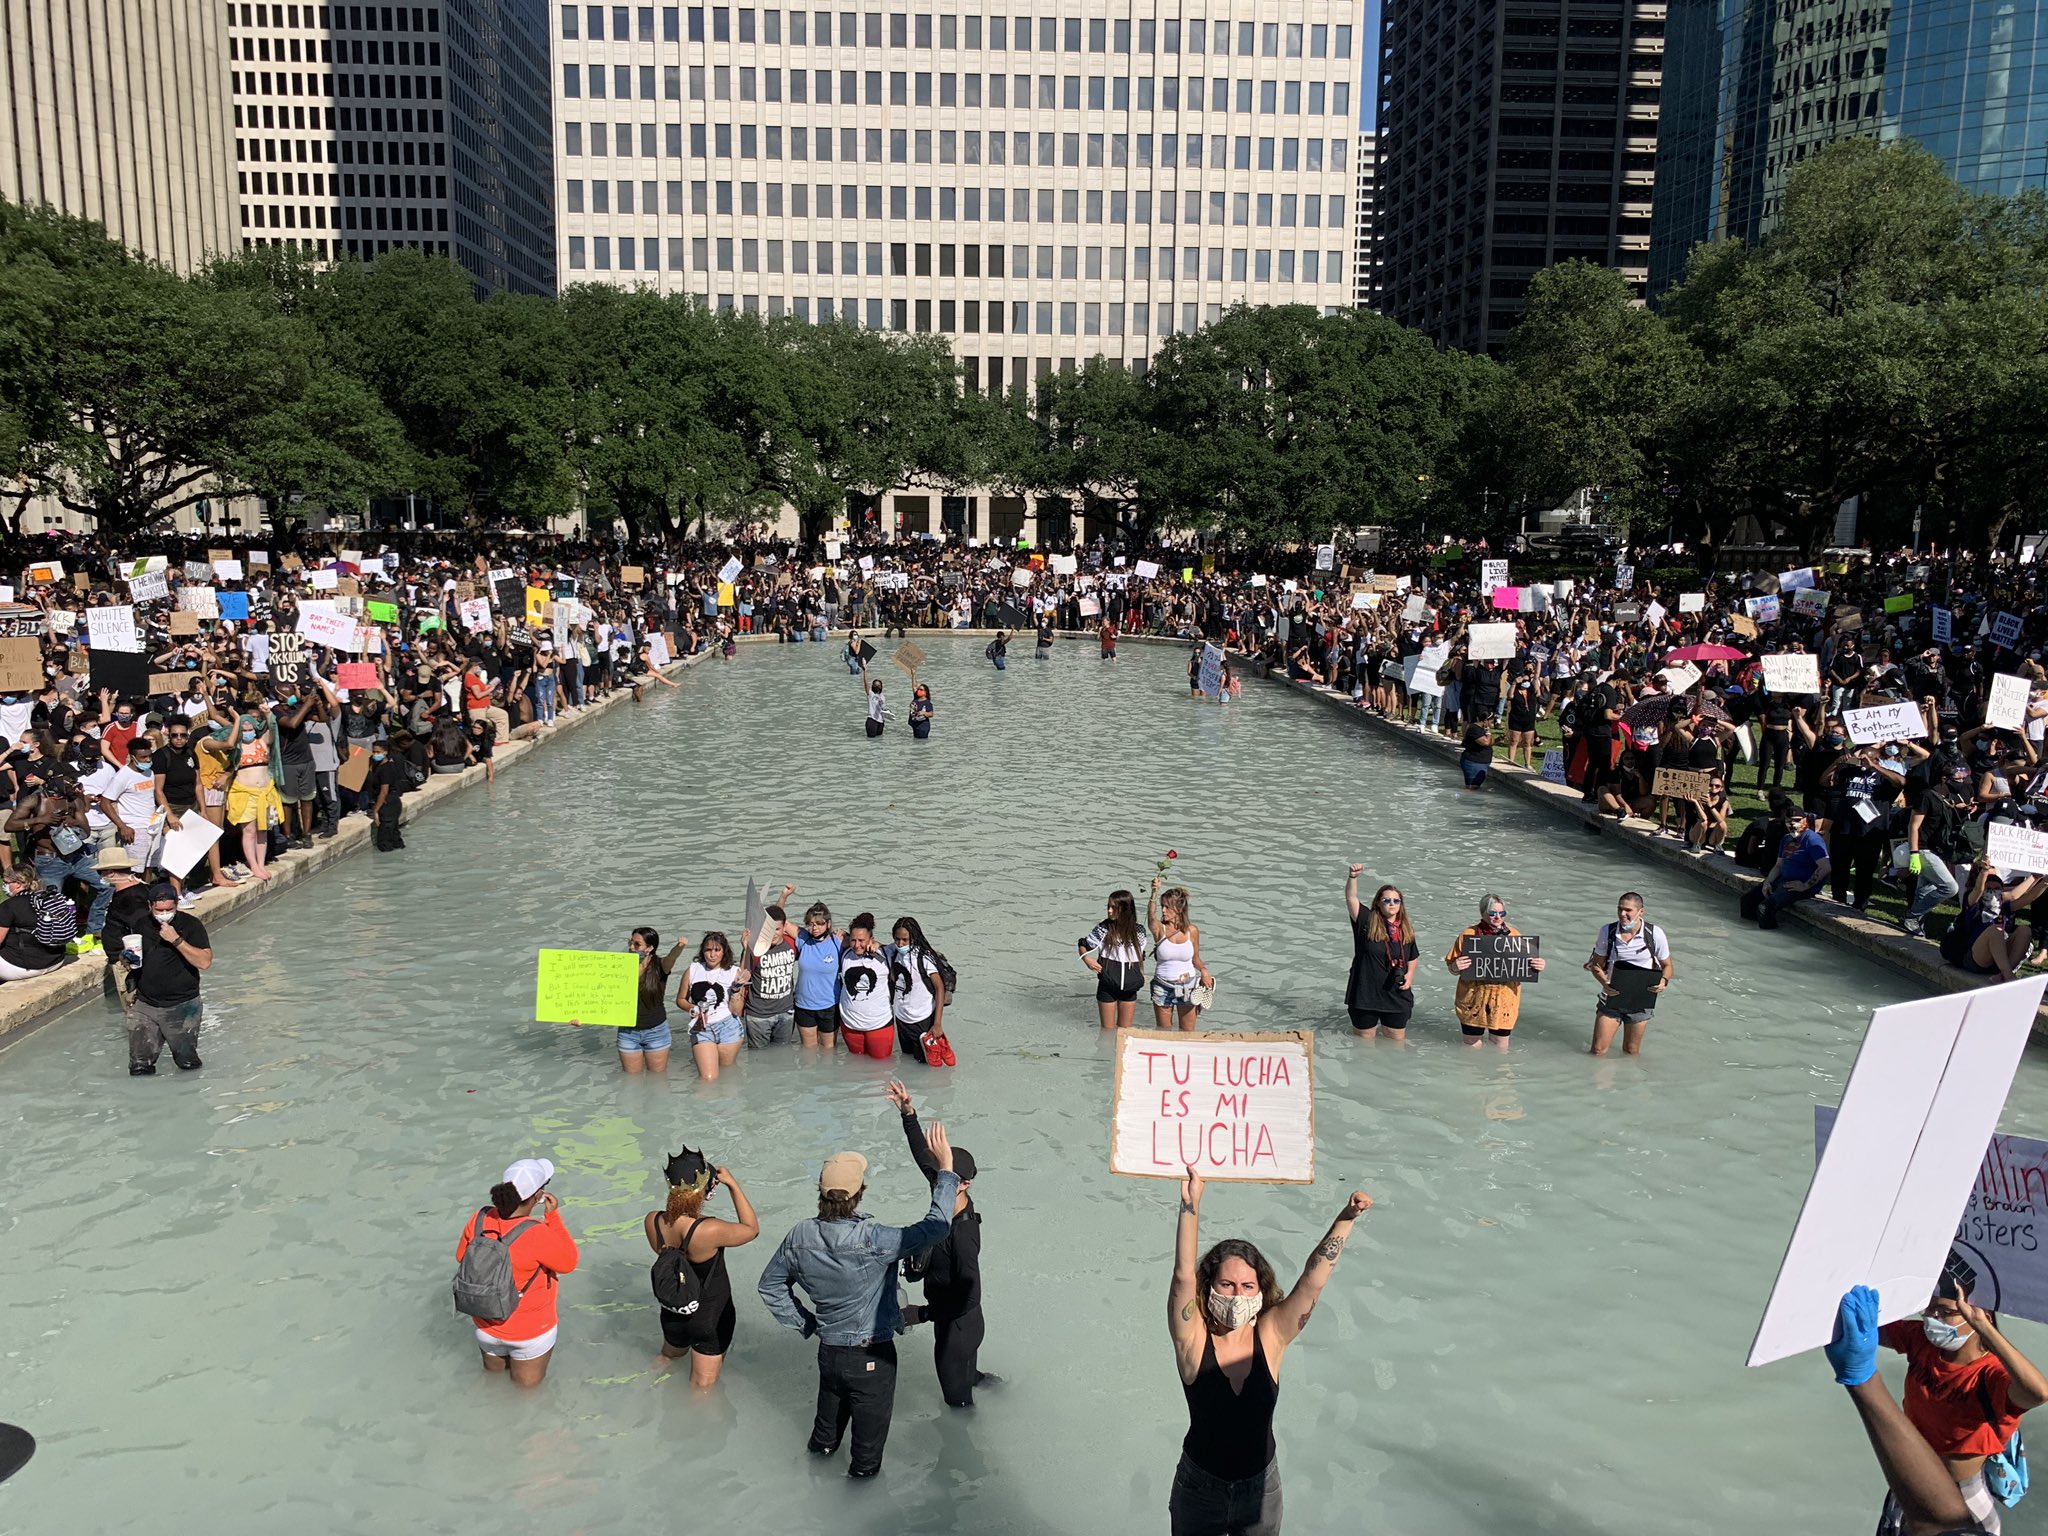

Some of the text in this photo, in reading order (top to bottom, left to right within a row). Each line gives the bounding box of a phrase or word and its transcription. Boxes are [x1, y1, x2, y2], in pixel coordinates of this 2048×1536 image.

[185, 561, 207, 572] FUCK
[90, 608, 126, 622] WHITE
[309, 613, 325, 622] SAY
[1998, 614, 2021, 630] BLACK
[90, 622, 130, 636] SILENCE
[310, 623, 336, 635] NAMES
[108, 635, 120, 648] IS
[269, 632, 305, 653] STOP
[276, 664, 298, 683] US
[1996, 675, 2012, 690] NO
[1991, 694, 2004, 706] NO
[1994, 687, 2028, 703] JUSTICE
[1850, 707, 1902, 722] I AM MY
[1992, 704, 2019, 719] PEACE
[1990, 824, 2015, 838] BLACK
[2017, 829, 2041, 844] PEOPLE
[1989, 849, 2023, 865] PROTECT
[1468, 937, 1482, 953] I
[760, 949, 795, 968] GAMING
[761, 965, 786, 978] MAKES
[1475, 957, 1534, 979] BREATHE
[1138, 1051, 1291, 1088] TU LUCHA
[1160, 1089, 1248, 1119] ES MI
[1151, 1120, 1279, 1169] LUCHA
[1983, 1195, 2036, 1217] Brown
